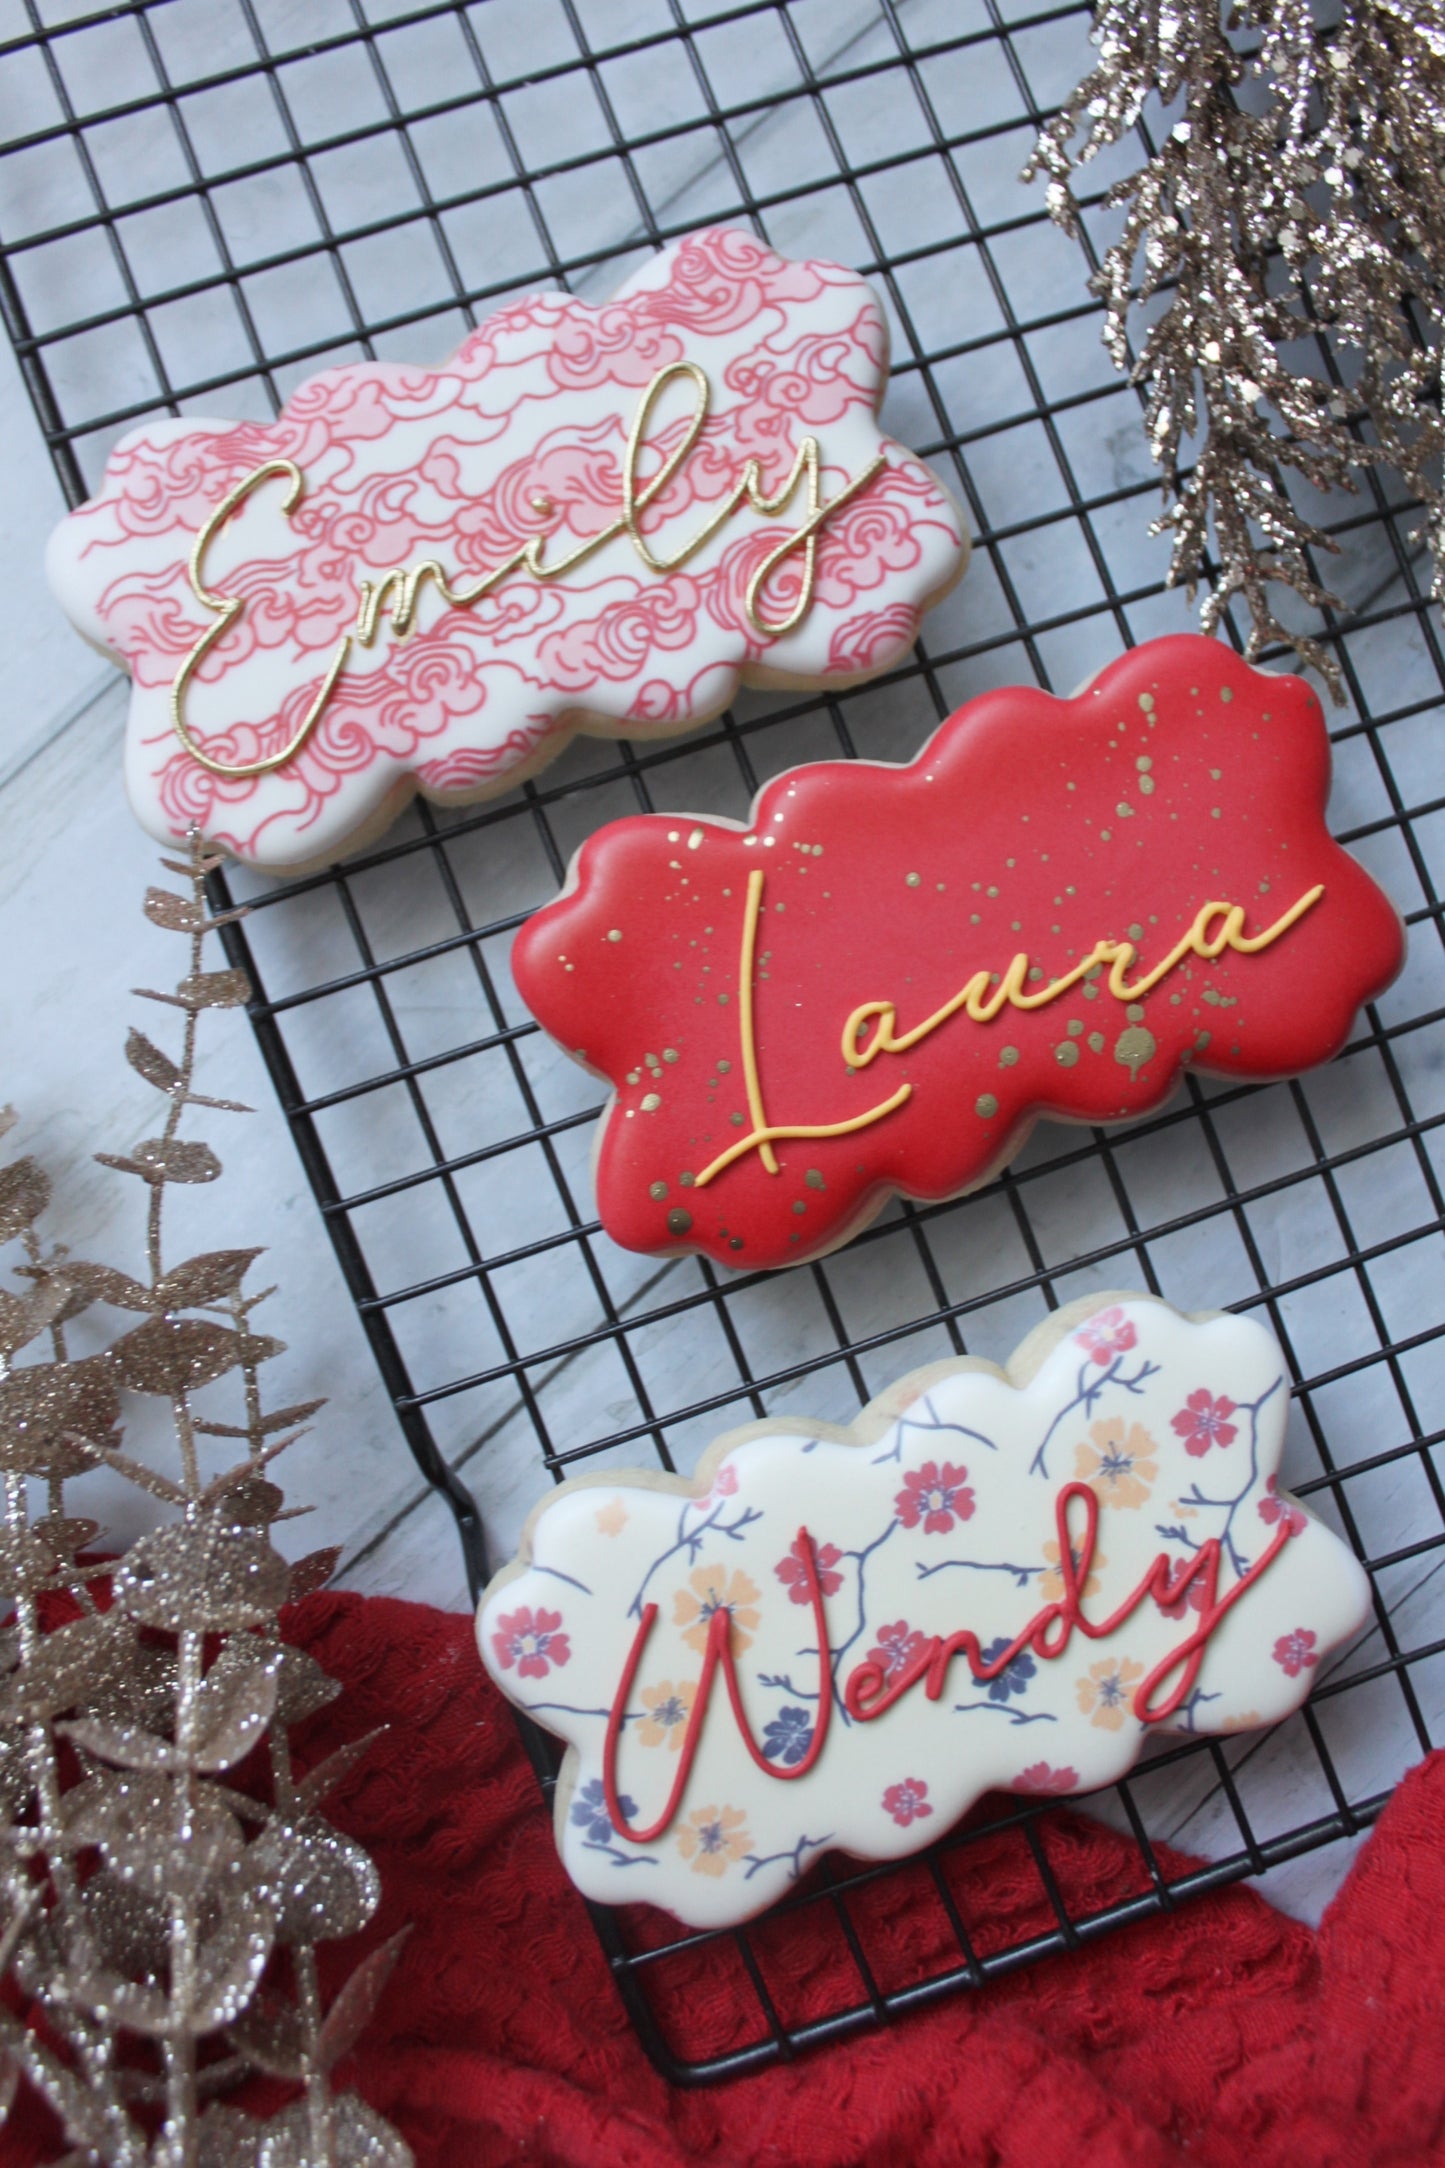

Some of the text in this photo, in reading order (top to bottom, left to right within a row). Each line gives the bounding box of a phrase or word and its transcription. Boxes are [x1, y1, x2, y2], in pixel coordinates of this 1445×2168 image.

[170, 360, 887, 777] Emily
[693, 868, 1326, 1188] Laura
[605, 1481, 1303, 1844] Wendy
